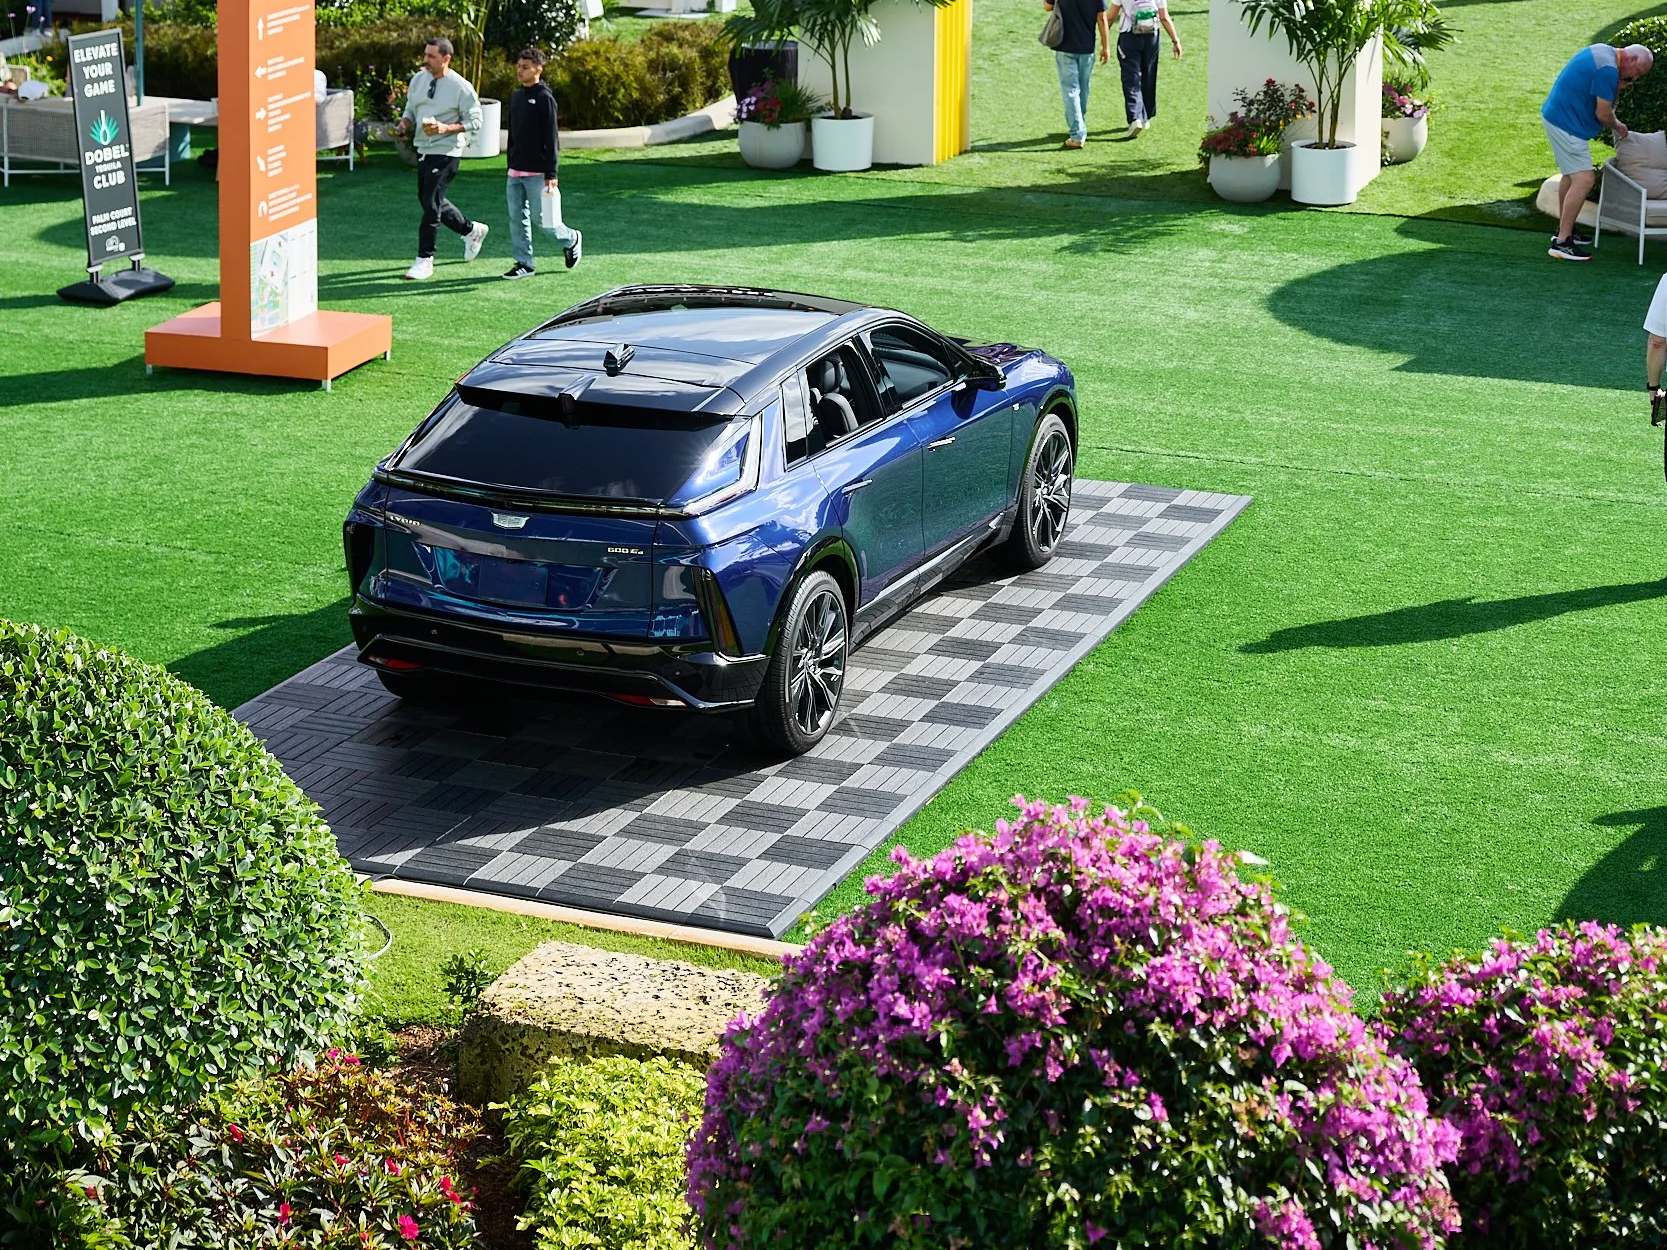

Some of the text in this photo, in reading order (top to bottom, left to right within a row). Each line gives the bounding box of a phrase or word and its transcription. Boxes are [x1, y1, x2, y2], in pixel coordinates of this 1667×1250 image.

[73, 42, 119, 64] ELEVATE
[82, 61, 113, 80] YOUR
[83, 79, 116, 98] GAME
[85, 144, 130, 166] DOBEL
[93, 170, 126, 190] CLUB
[110, 206, 133, 221] COURT
[90, 216, 137, 237] SECOND LEVEL
